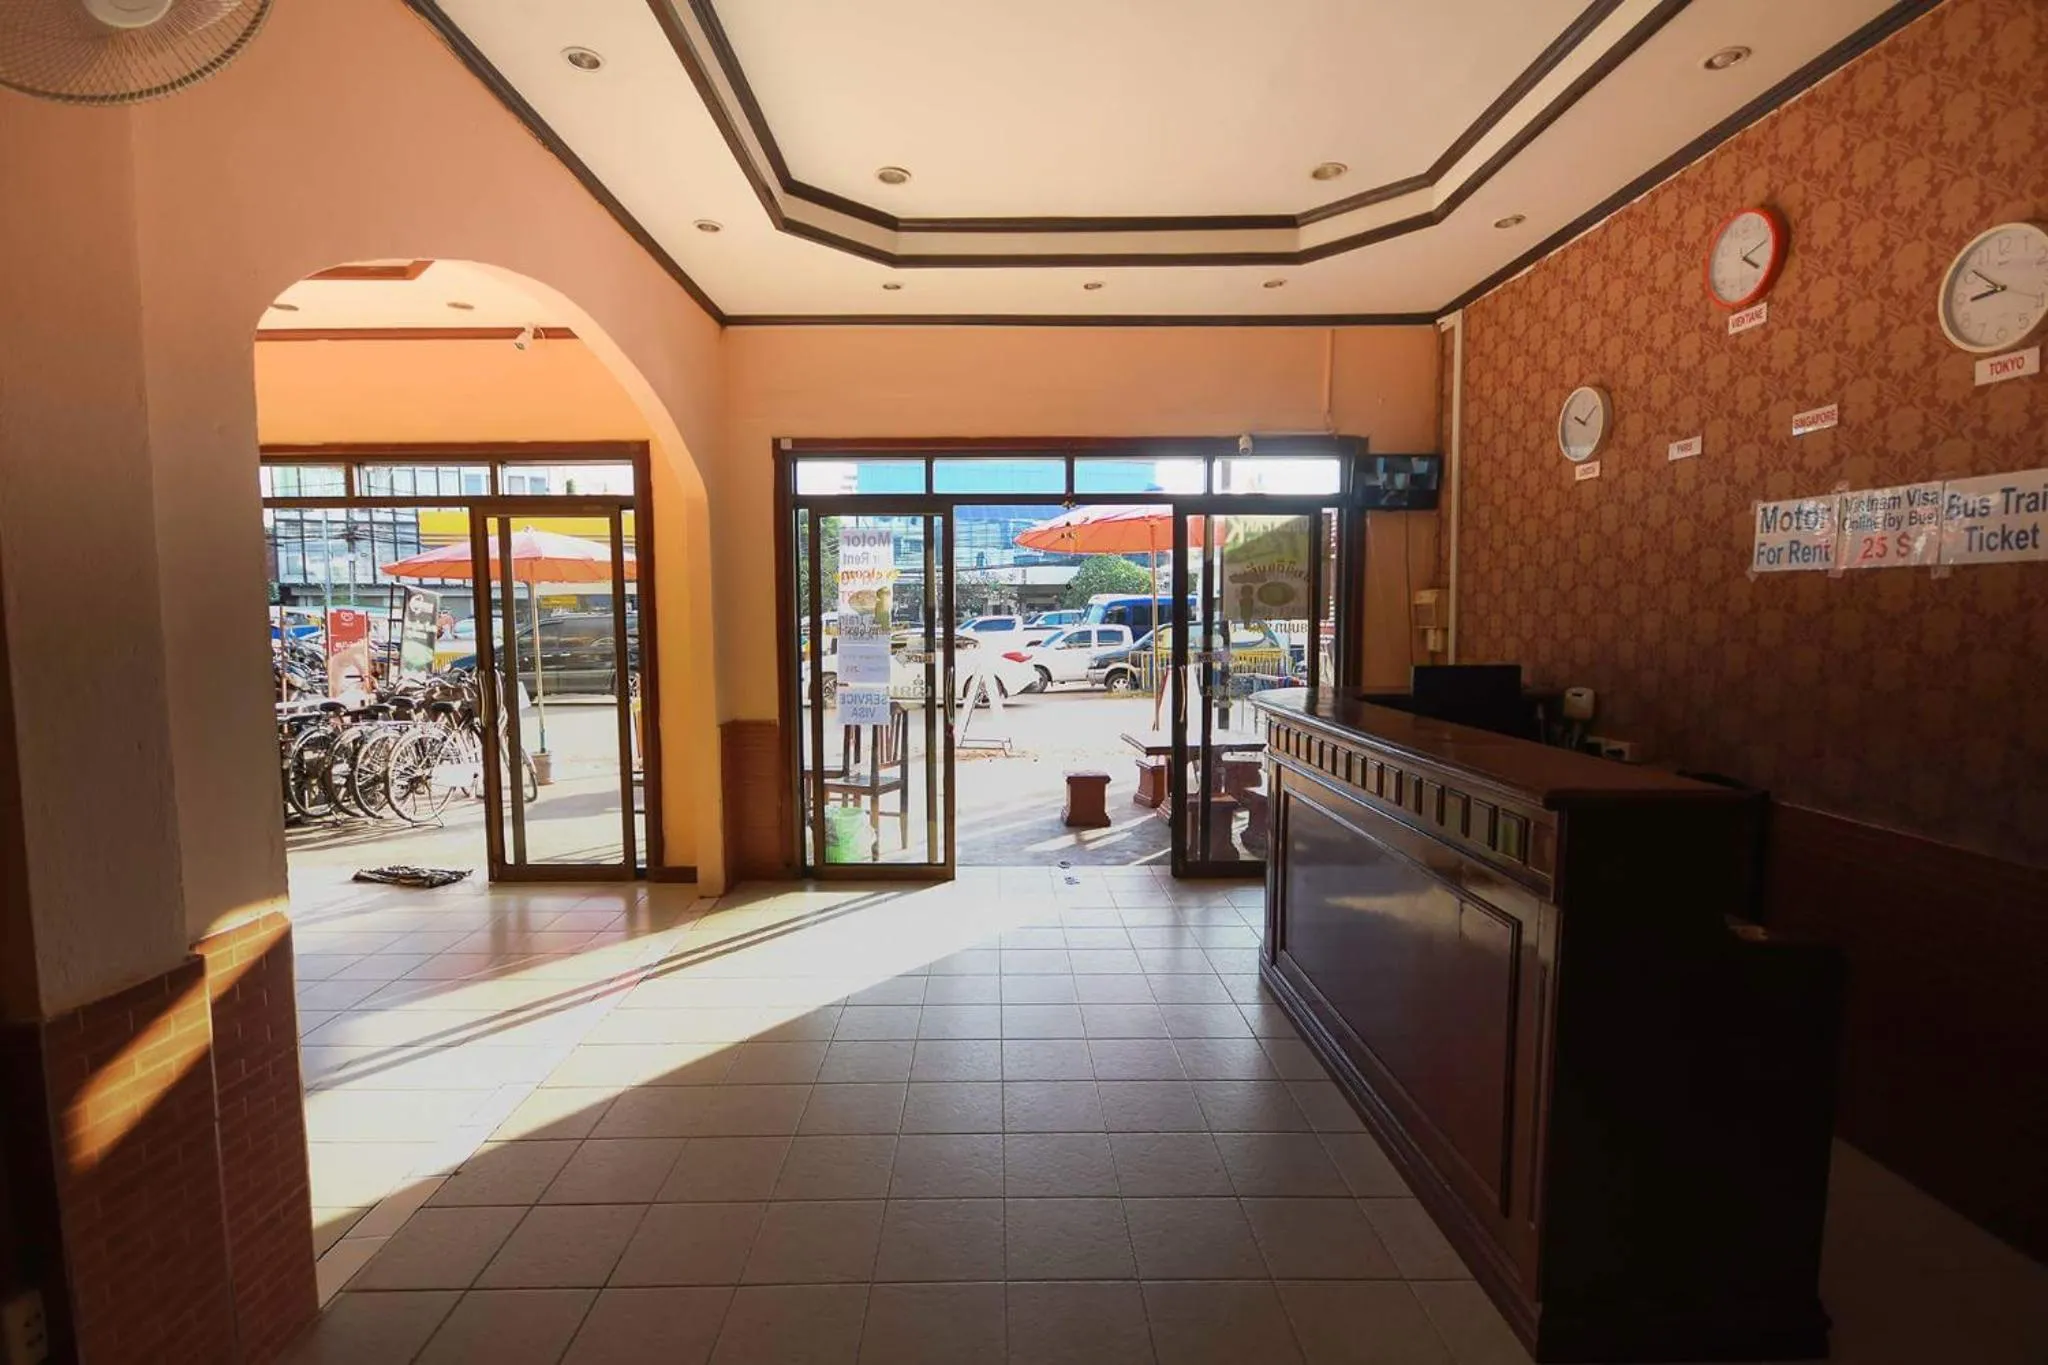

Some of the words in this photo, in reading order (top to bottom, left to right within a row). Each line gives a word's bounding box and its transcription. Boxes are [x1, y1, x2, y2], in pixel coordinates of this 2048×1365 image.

[1989, 356, 2025, 376] TOKYO
[1793, 409, 1836, 429] SINGAPORE
[1844, 495, 1901, 513] Vietnam
[1907, 488, 1939, 507] Visa
[1945, 492, 1991, 520] Bus
[2000, 483, 2048, 515] Trai
[1760, 504, 1832, 533] Motor
[1861, 536, 1888, 559] 25
[1895, 532, 1911, 558] $
[1963, 522, 2040, 553] Ticket
[1756, 542, 1784, 566] For
[1788, 540, 1832, 564] Rent
